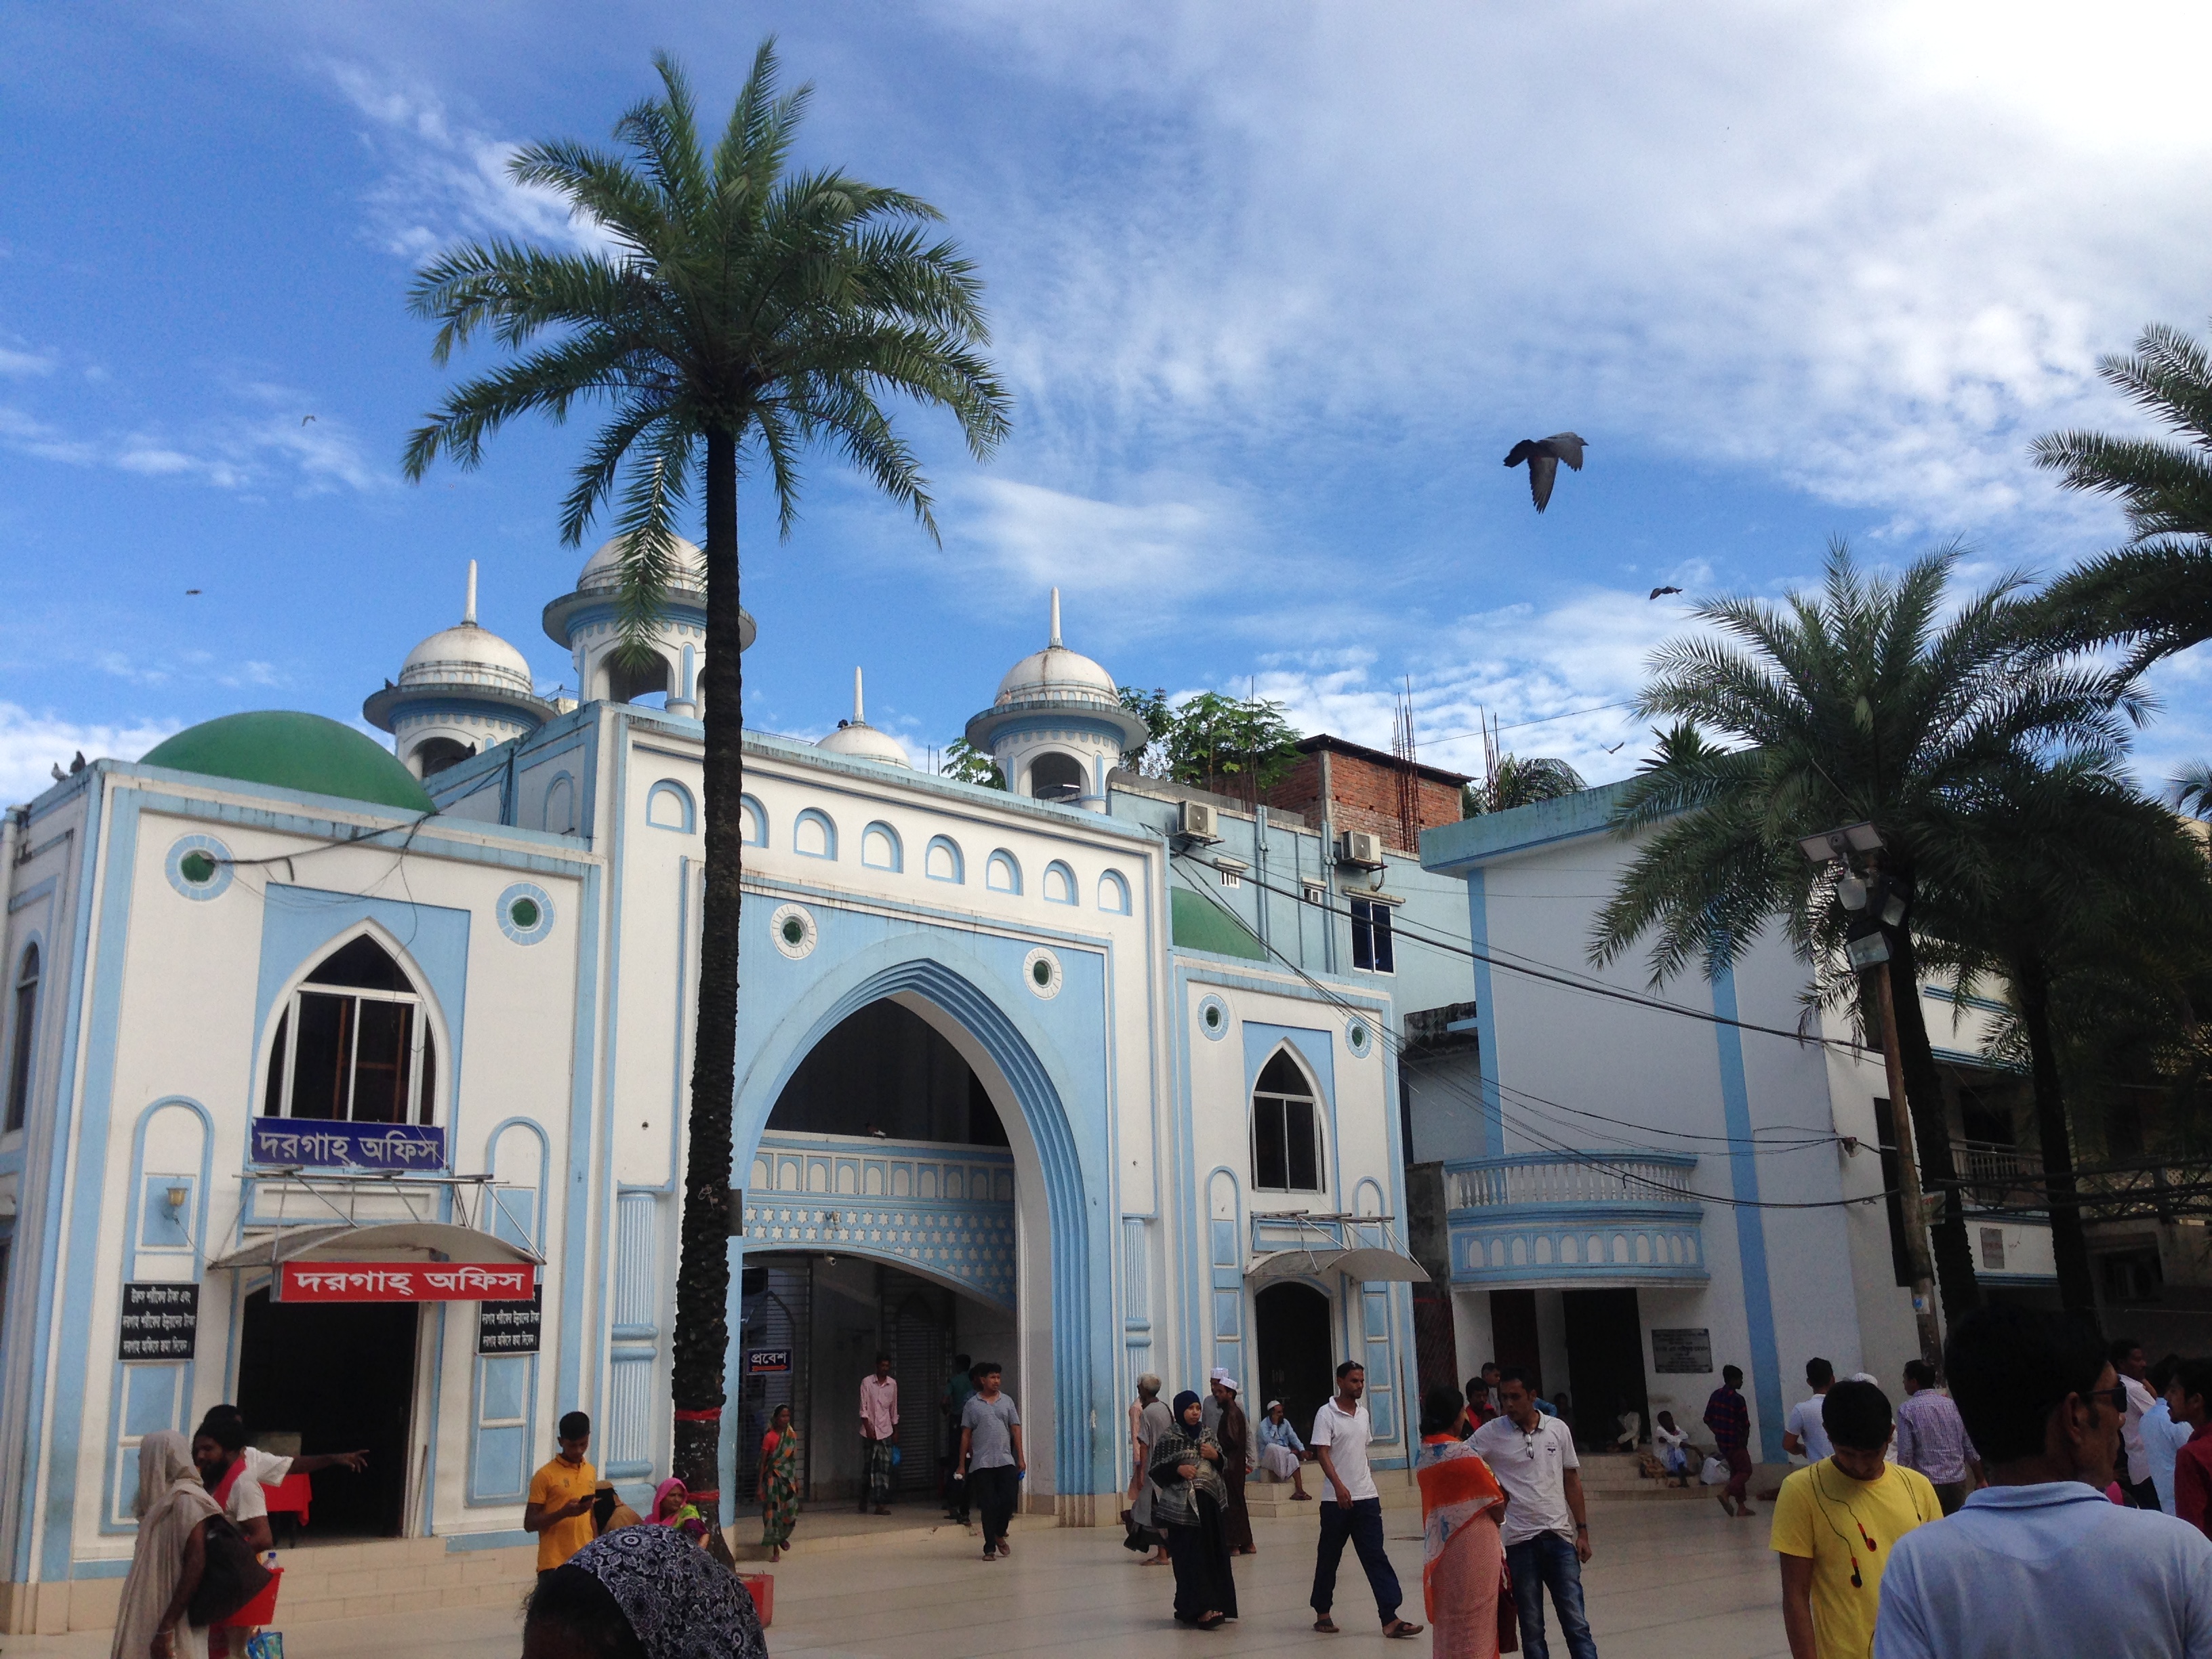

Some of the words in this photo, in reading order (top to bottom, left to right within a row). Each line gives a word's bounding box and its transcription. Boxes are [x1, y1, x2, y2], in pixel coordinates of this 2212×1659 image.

[357, 1130, 439, 1164] অফিস
[423, 1267, 527, 1292] অফিস
[751, 1351, 787, 1365] প্রবেশ
